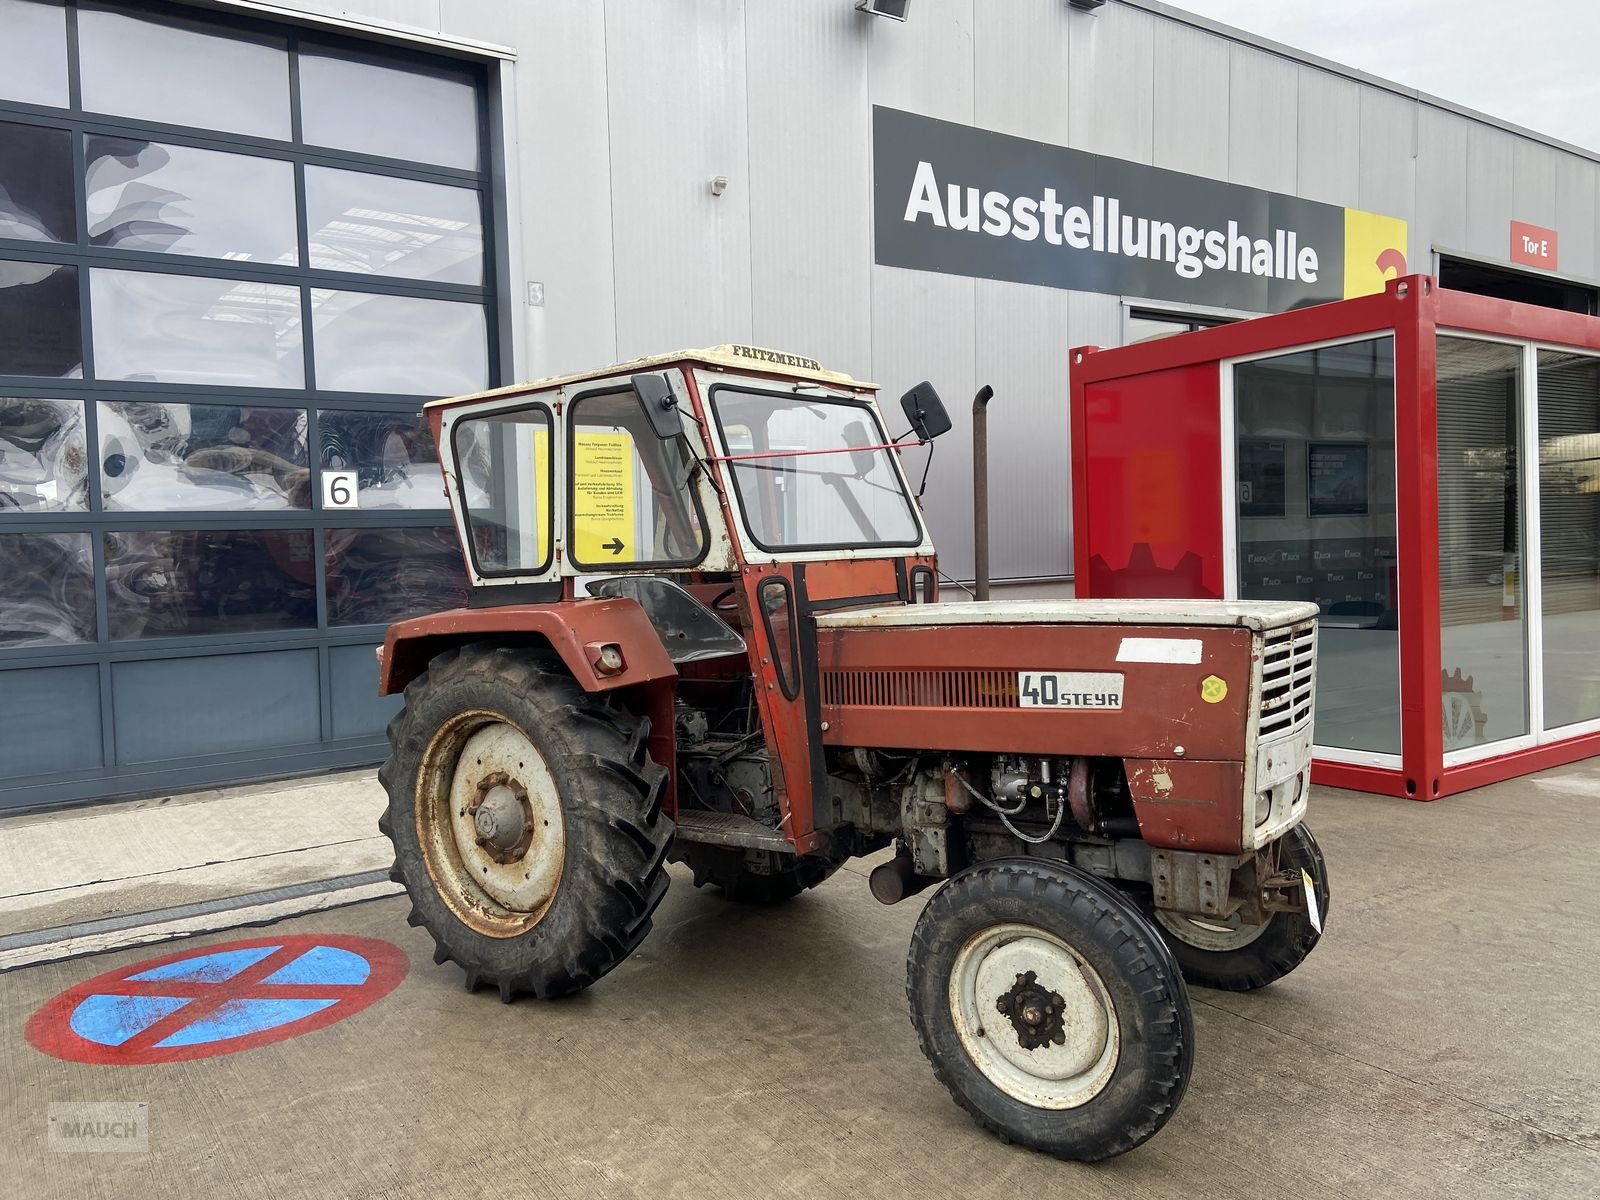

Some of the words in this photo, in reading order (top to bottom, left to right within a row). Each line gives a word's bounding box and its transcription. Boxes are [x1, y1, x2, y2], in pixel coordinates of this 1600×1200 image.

[903, 160, 1319, 283] Ausstellungshalle
[1522, 235, 1539, 255] Tor
[1541, 240, 1548, 257] E
[732, 345, 821, 371] FRITZMEIER
[331, 476, 350, 505] 6
[1022, 675, 1058, 705] 40
[1061, 693, 1119, 705] STEYR
